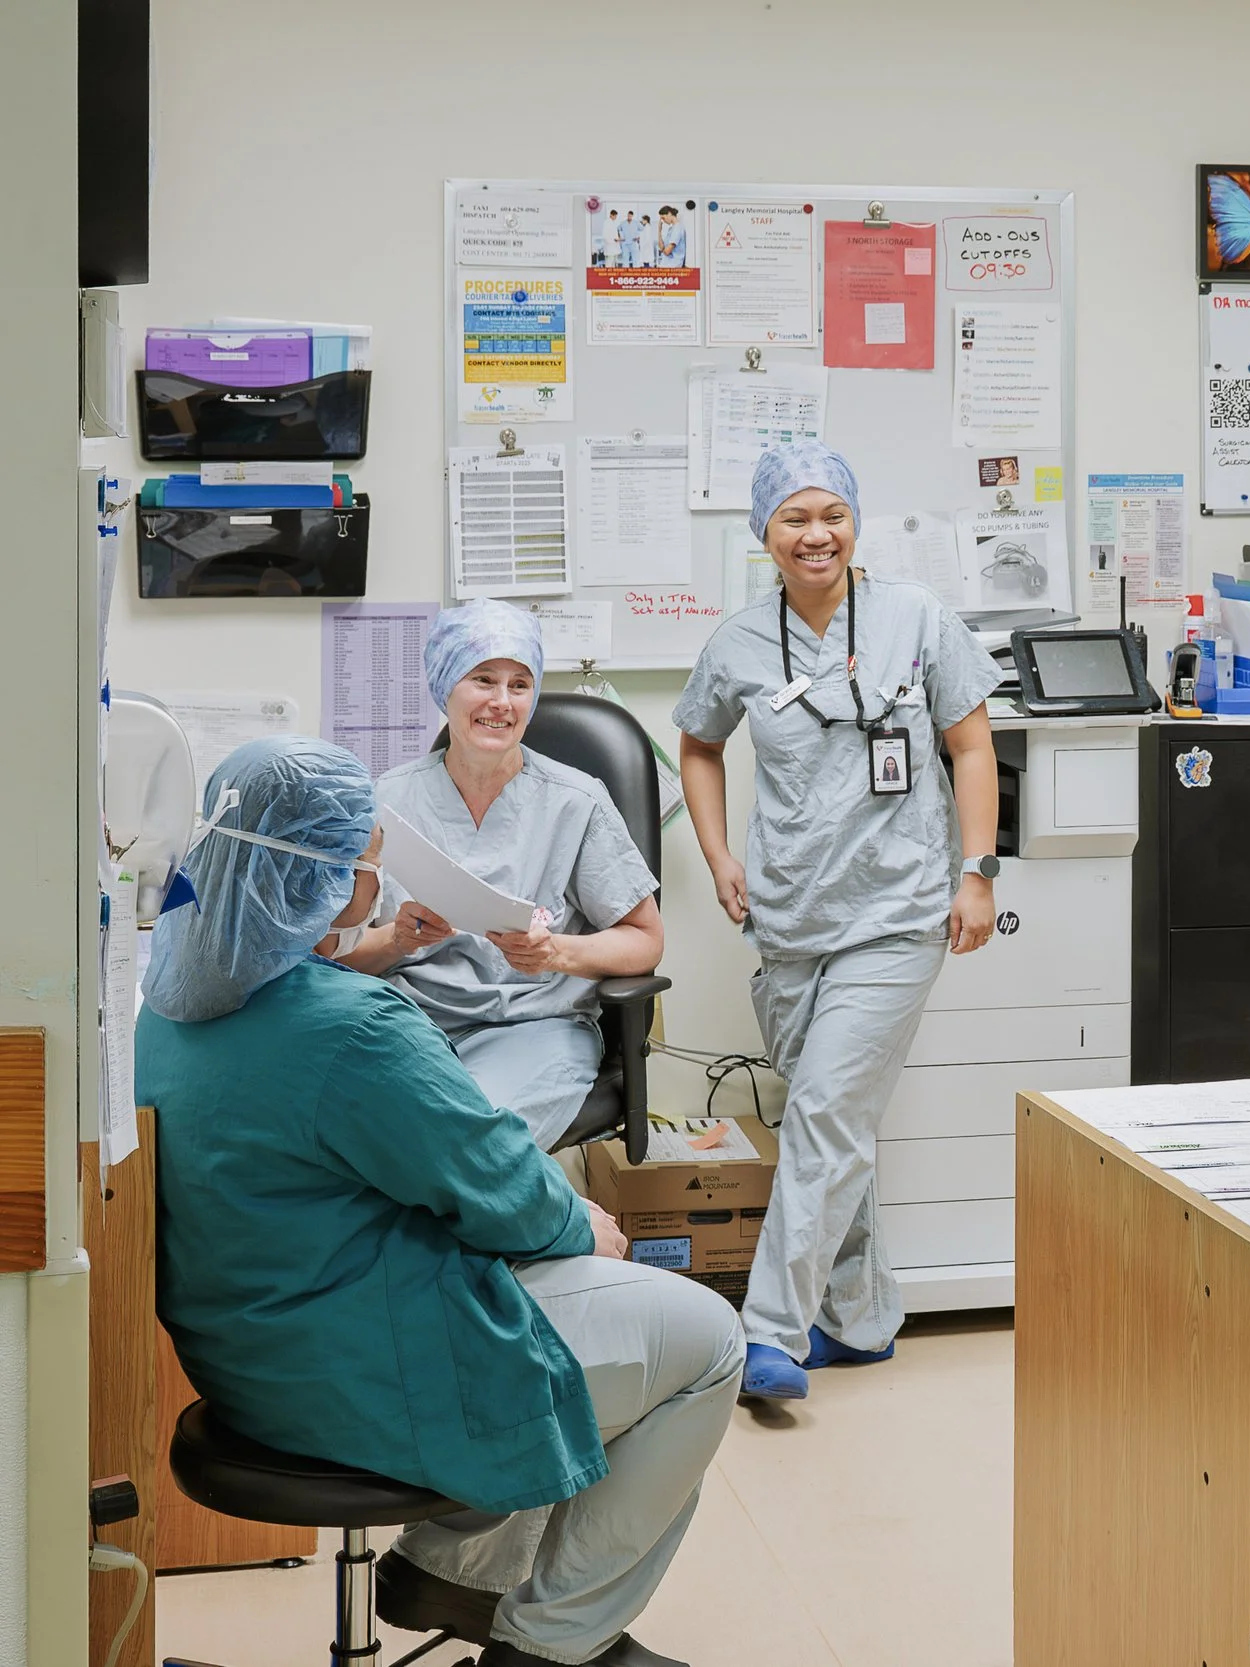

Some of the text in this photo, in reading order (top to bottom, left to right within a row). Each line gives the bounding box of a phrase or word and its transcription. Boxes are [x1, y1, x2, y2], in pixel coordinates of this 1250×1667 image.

[751, 217, 773, 225] STAFF
[962, 228, 1040, 242] ADD ONS
[464, 280, 564, 293] PROCEDURES
[977, 512, 989, 520] DO
[972, 525, 986, 533] SCD
[625, 592, 653, 606] Only
